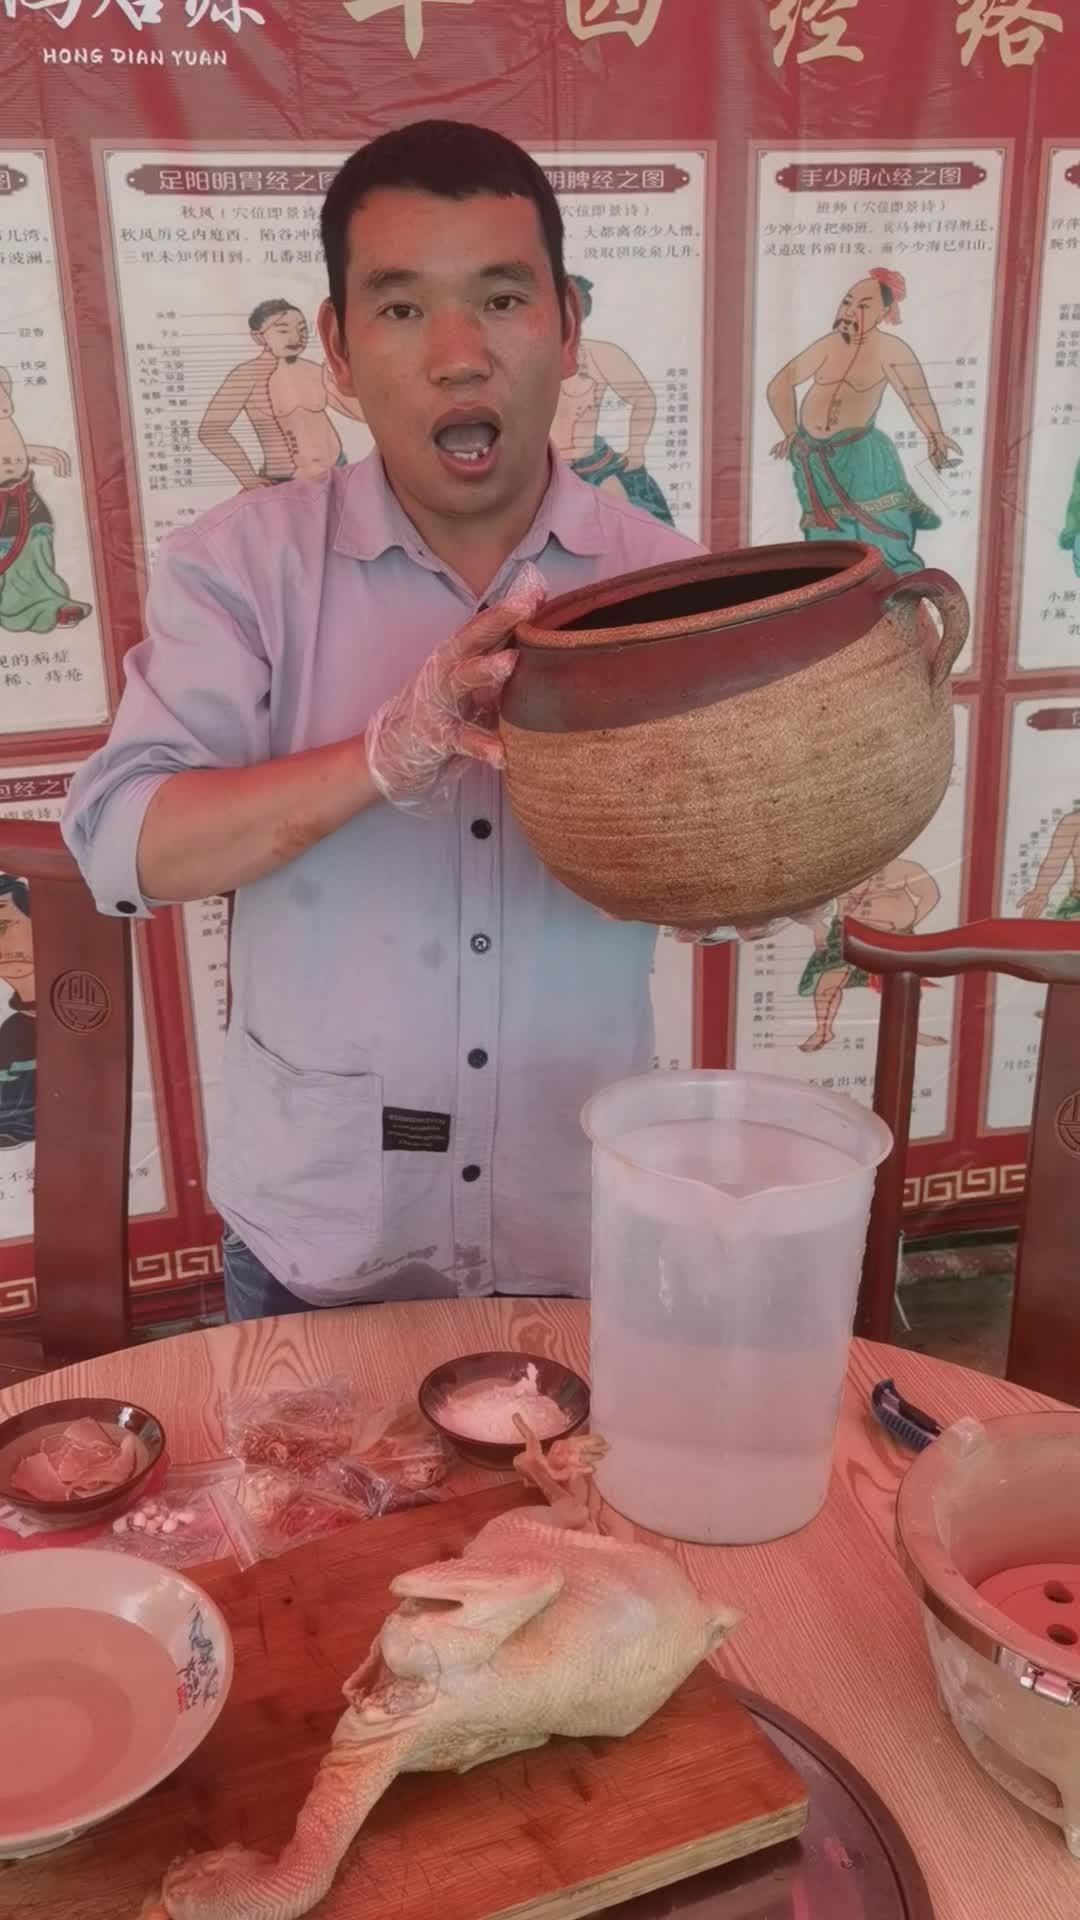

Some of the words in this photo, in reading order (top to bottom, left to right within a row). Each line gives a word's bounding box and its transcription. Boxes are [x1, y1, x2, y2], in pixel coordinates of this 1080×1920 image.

[43, 48, 103, 64] HONG
[110, 48, 164, 65] DIAN
[171, 50, 227, 66] YUAN
[801, 166, 962, 187] 手少阴心经之图
